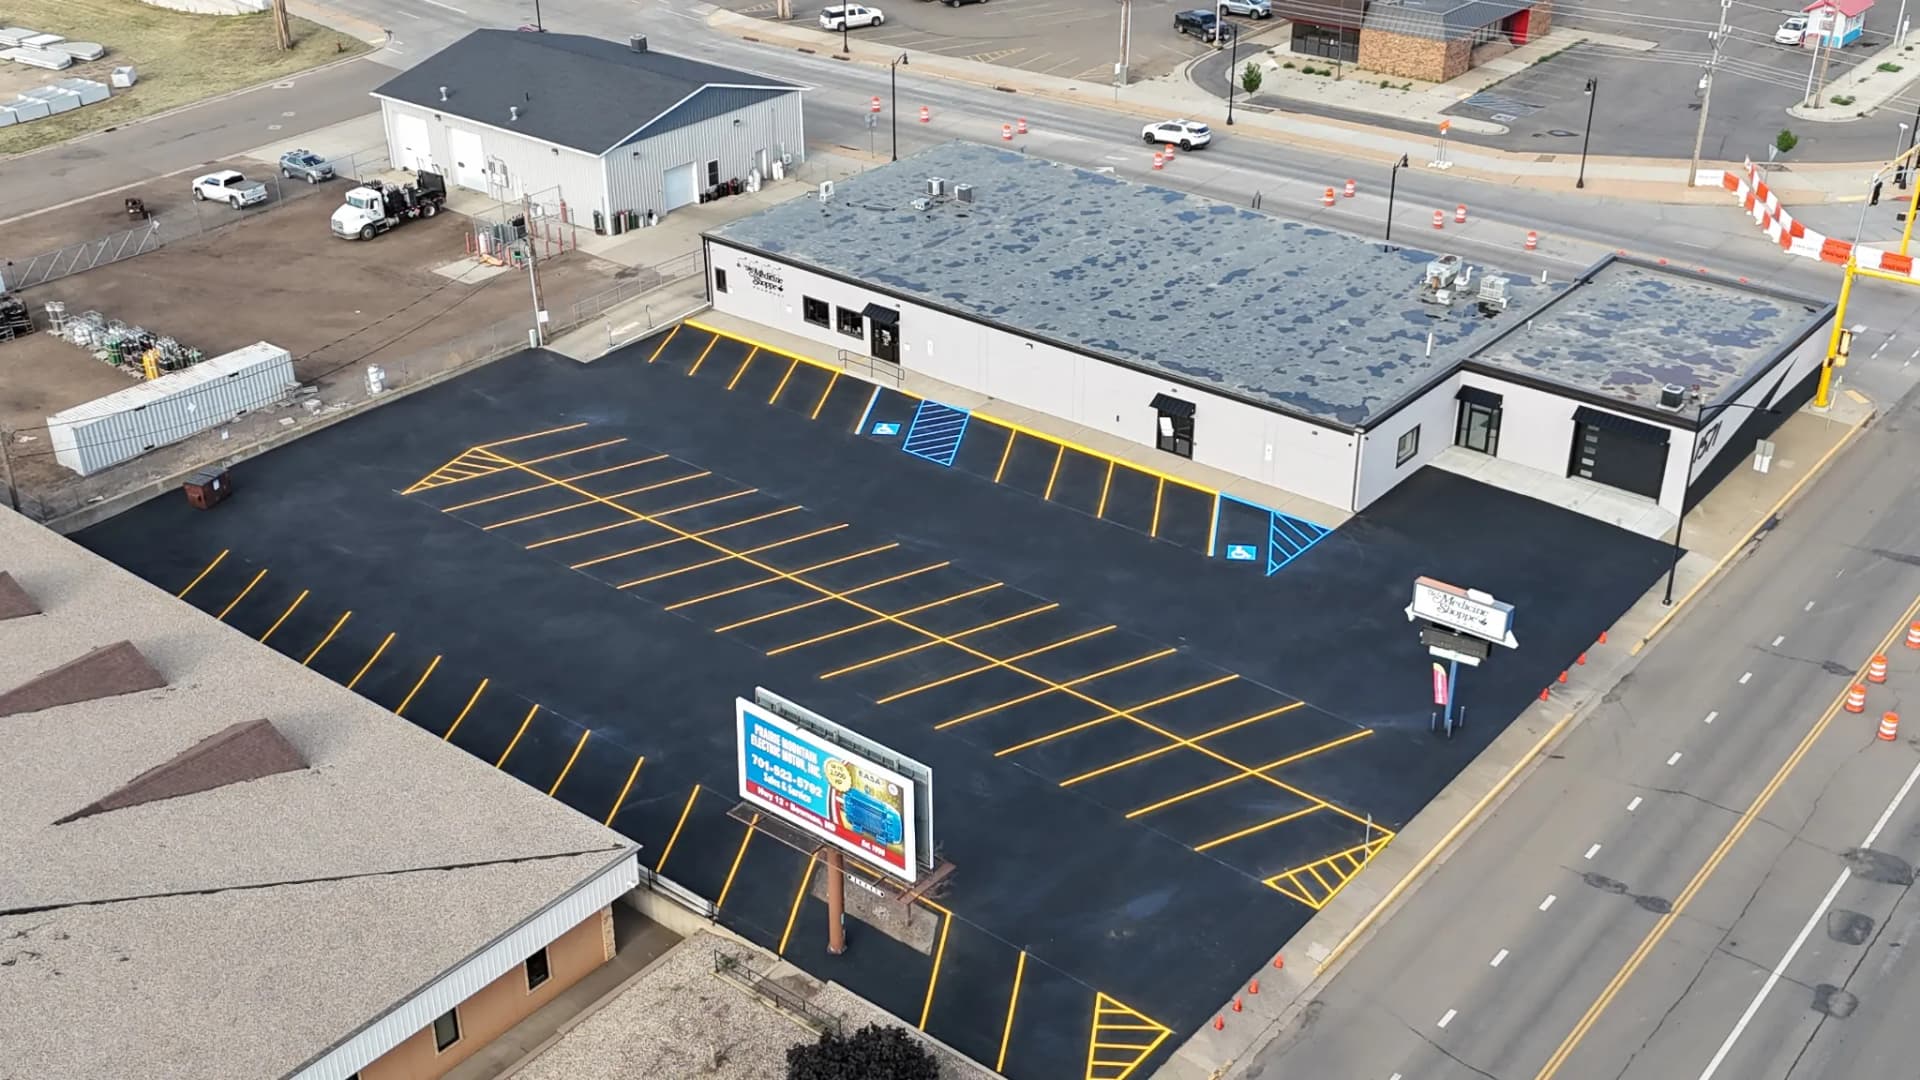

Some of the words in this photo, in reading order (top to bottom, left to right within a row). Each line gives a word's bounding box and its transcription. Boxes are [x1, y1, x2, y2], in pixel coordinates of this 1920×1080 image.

[1434, 594, 1488, 617] Medicine
[1437, 603, 1478, 621] Shoppe
[750, 733, 781, 759] ELECTRIC
[754, 723, 780, 747] PRAIRIE
[781, 736, 818, 764] MOUNTAIN
[763, 772, 781, 788] Sales
[787, 784, 812, 804] Service
[858, 769, 880, 785] EASA
[757, 786, 774, 801] Hwy
[774, 795, 785, 806] 12
